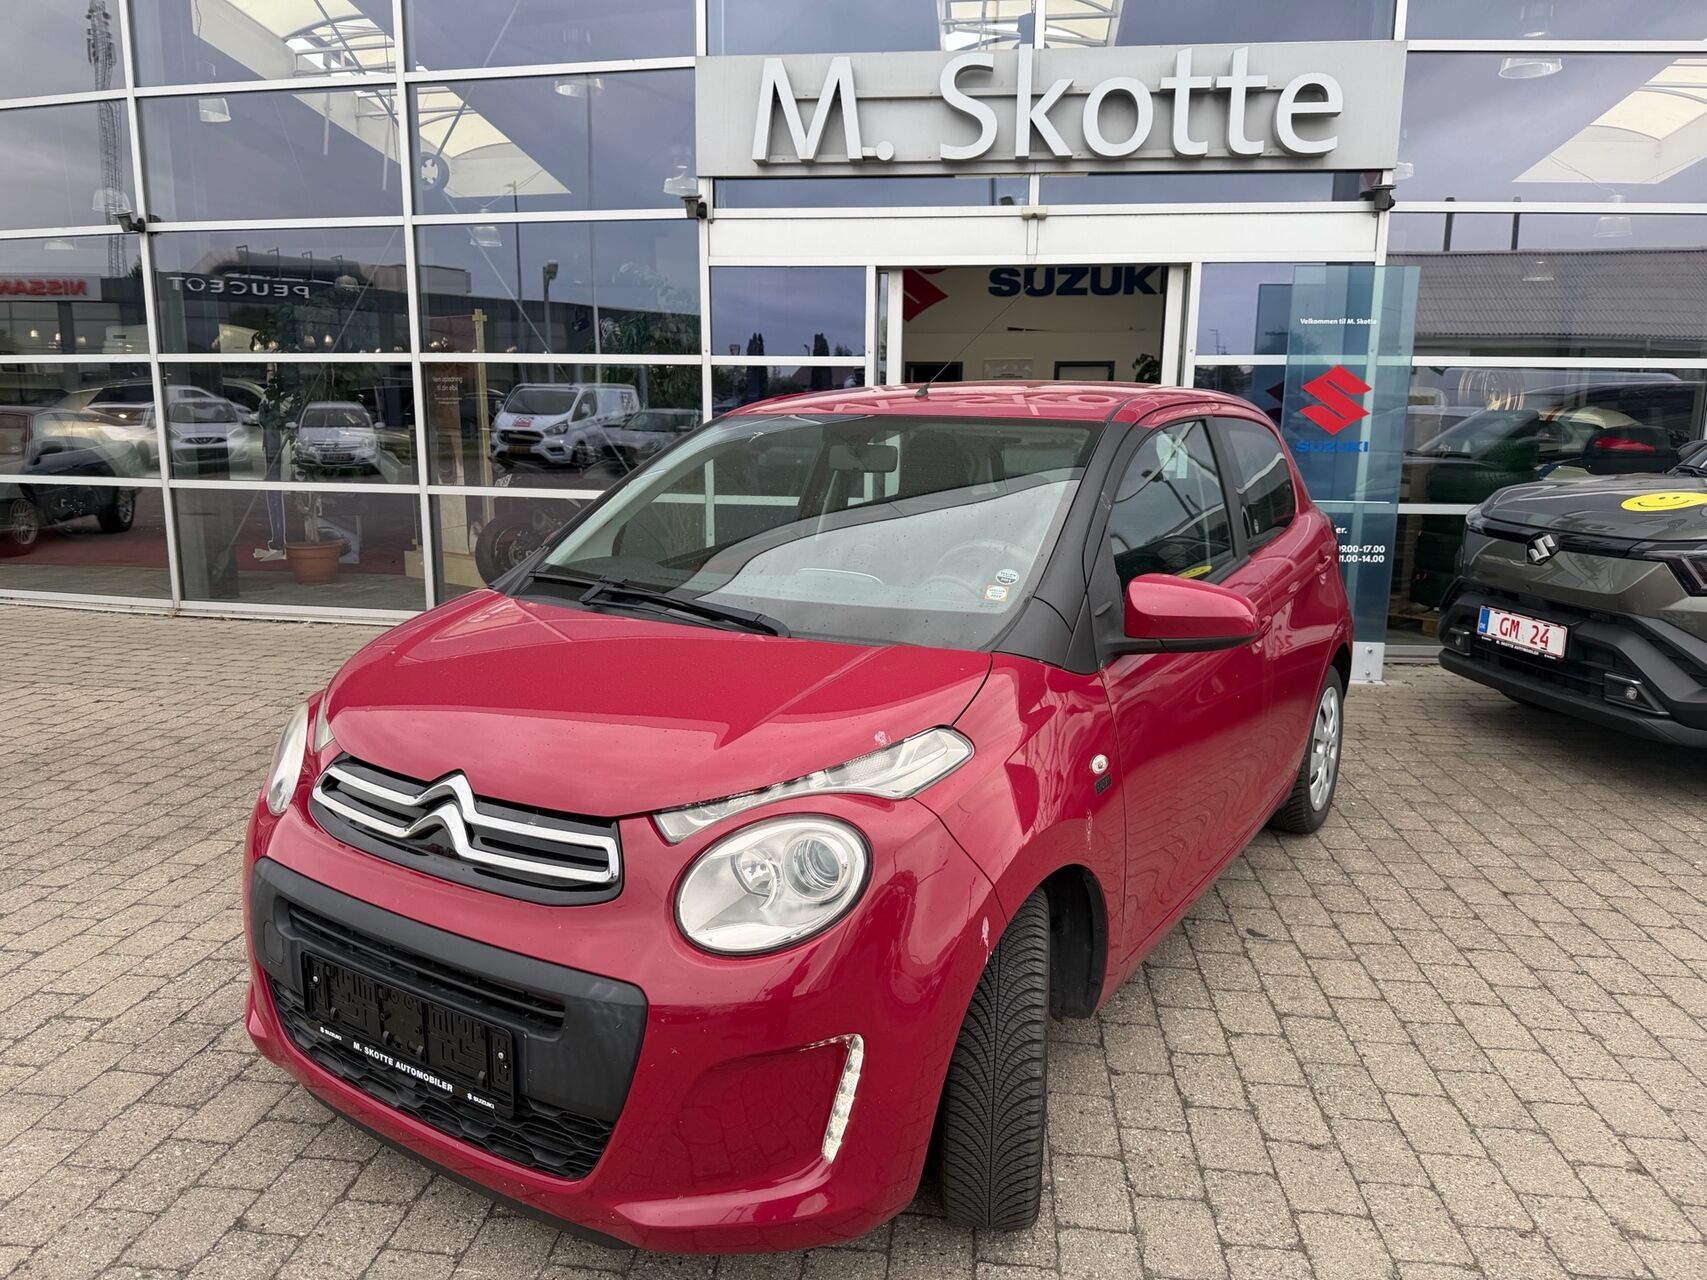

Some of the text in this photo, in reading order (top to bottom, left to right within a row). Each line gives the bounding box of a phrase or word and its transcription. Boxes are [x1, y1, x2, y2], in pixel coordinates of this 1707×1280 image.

[752, 43, 1344, 165] M. Skotte
[1295, 441, 1369, 453] SUZUKI
[1500, 617, 1550, 648] GM 24
[353, 1041, 454, 1093] M. SKOTTE AUTOMOBILER
